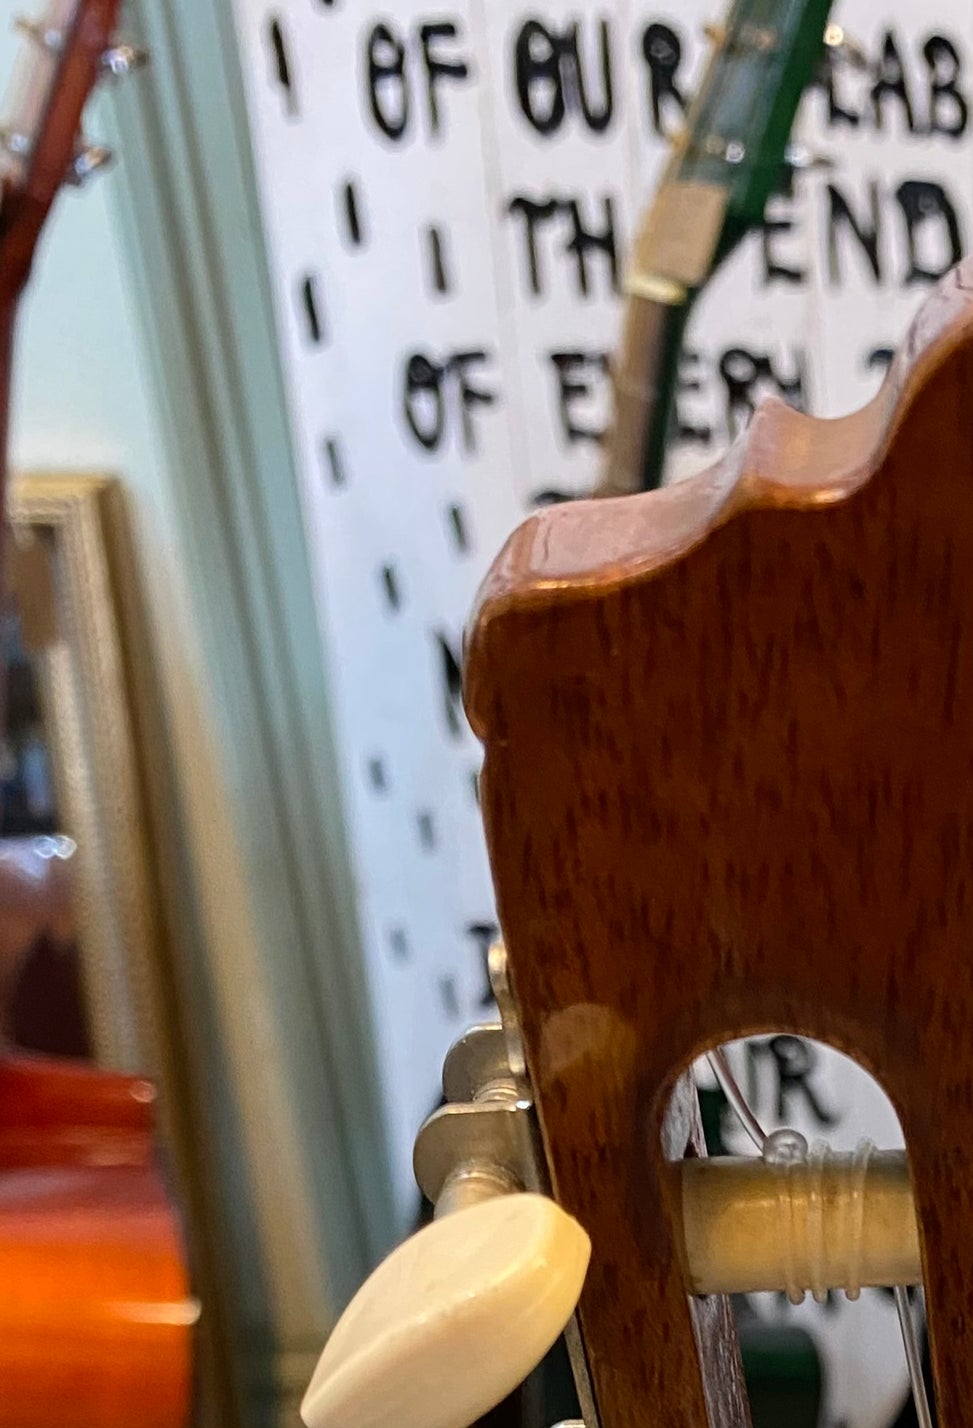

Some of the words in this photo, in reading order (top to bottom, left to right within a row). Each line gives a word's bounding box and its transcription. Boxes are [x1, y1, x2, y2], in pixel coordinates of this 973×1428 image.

[366, 22, 468, 140] OF
[508, 197, 622, 294] TH
[405, 351, 492, 449] OF
